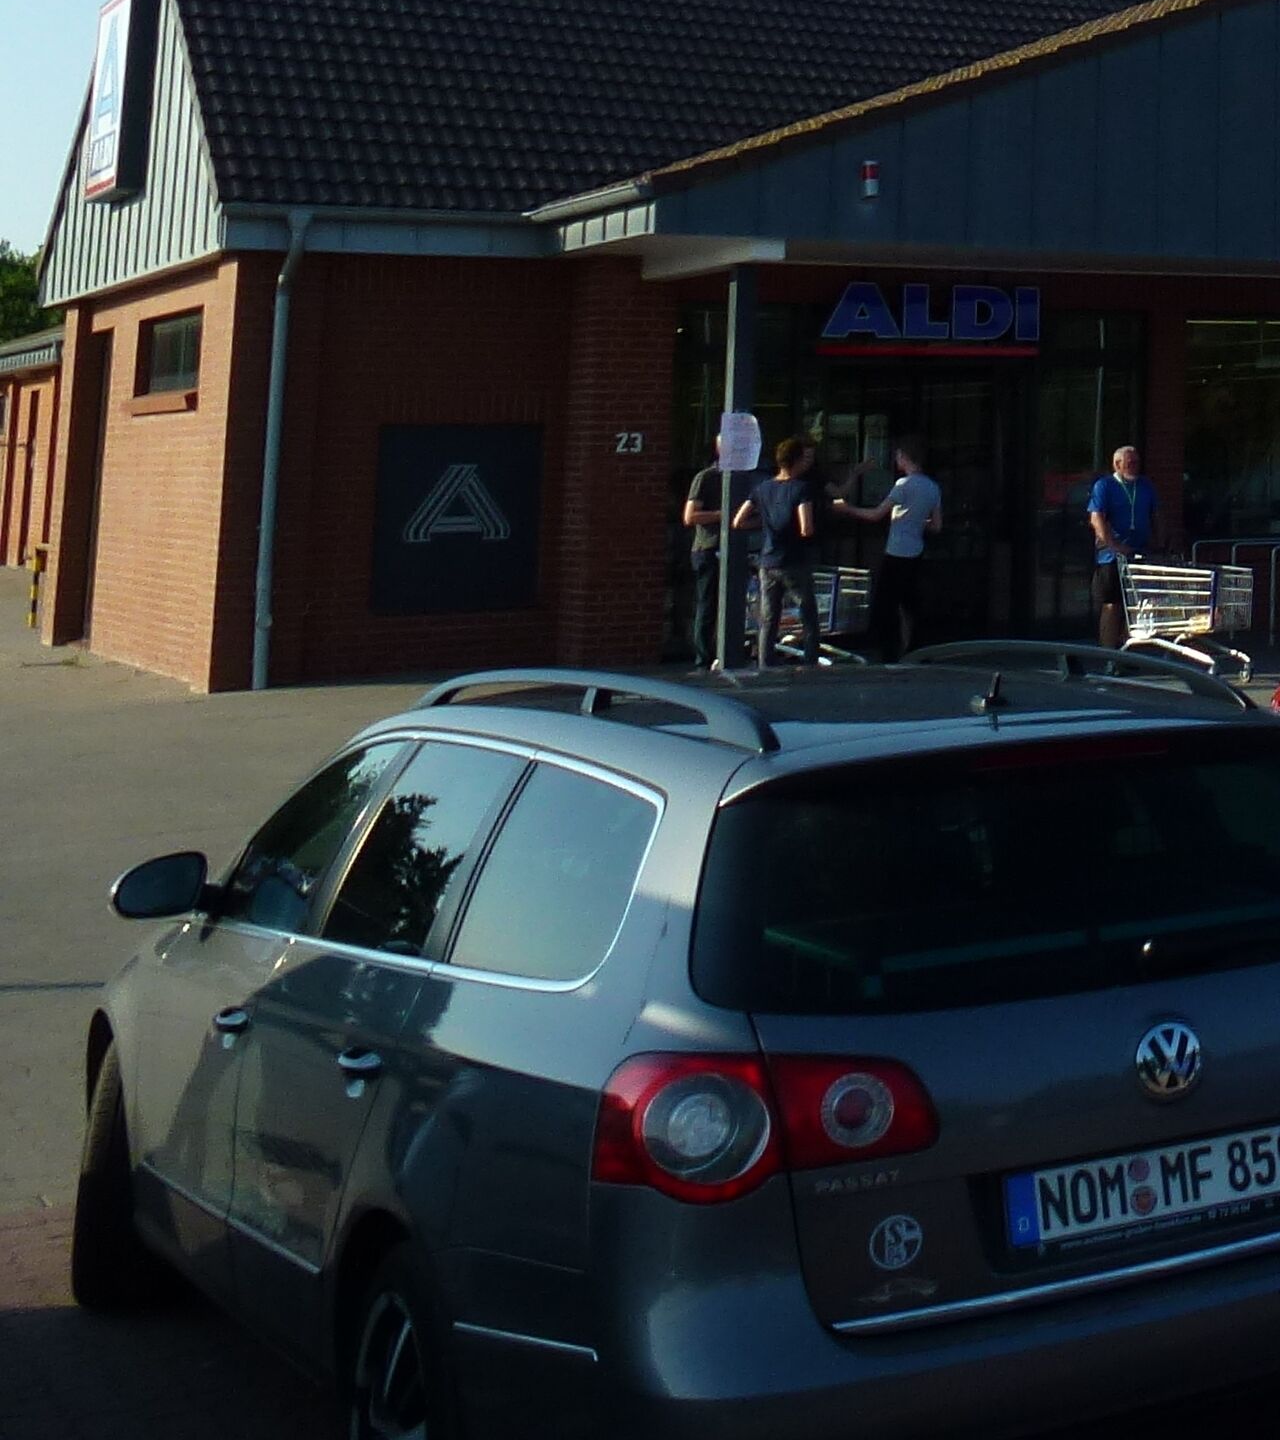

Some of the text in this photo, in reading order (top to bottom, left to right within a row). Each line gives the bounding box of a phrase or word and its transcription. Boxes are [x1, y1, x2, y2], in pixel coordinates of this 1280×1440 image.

[821, 281, 1040, 341] ALDI
[615, 432, 643, 453] 23
[815, 1168, 900, 1193] PASSAT
[1038, 1163, 1130, 1231] NOM
[1159, 1146, 1213, 1207] MF
